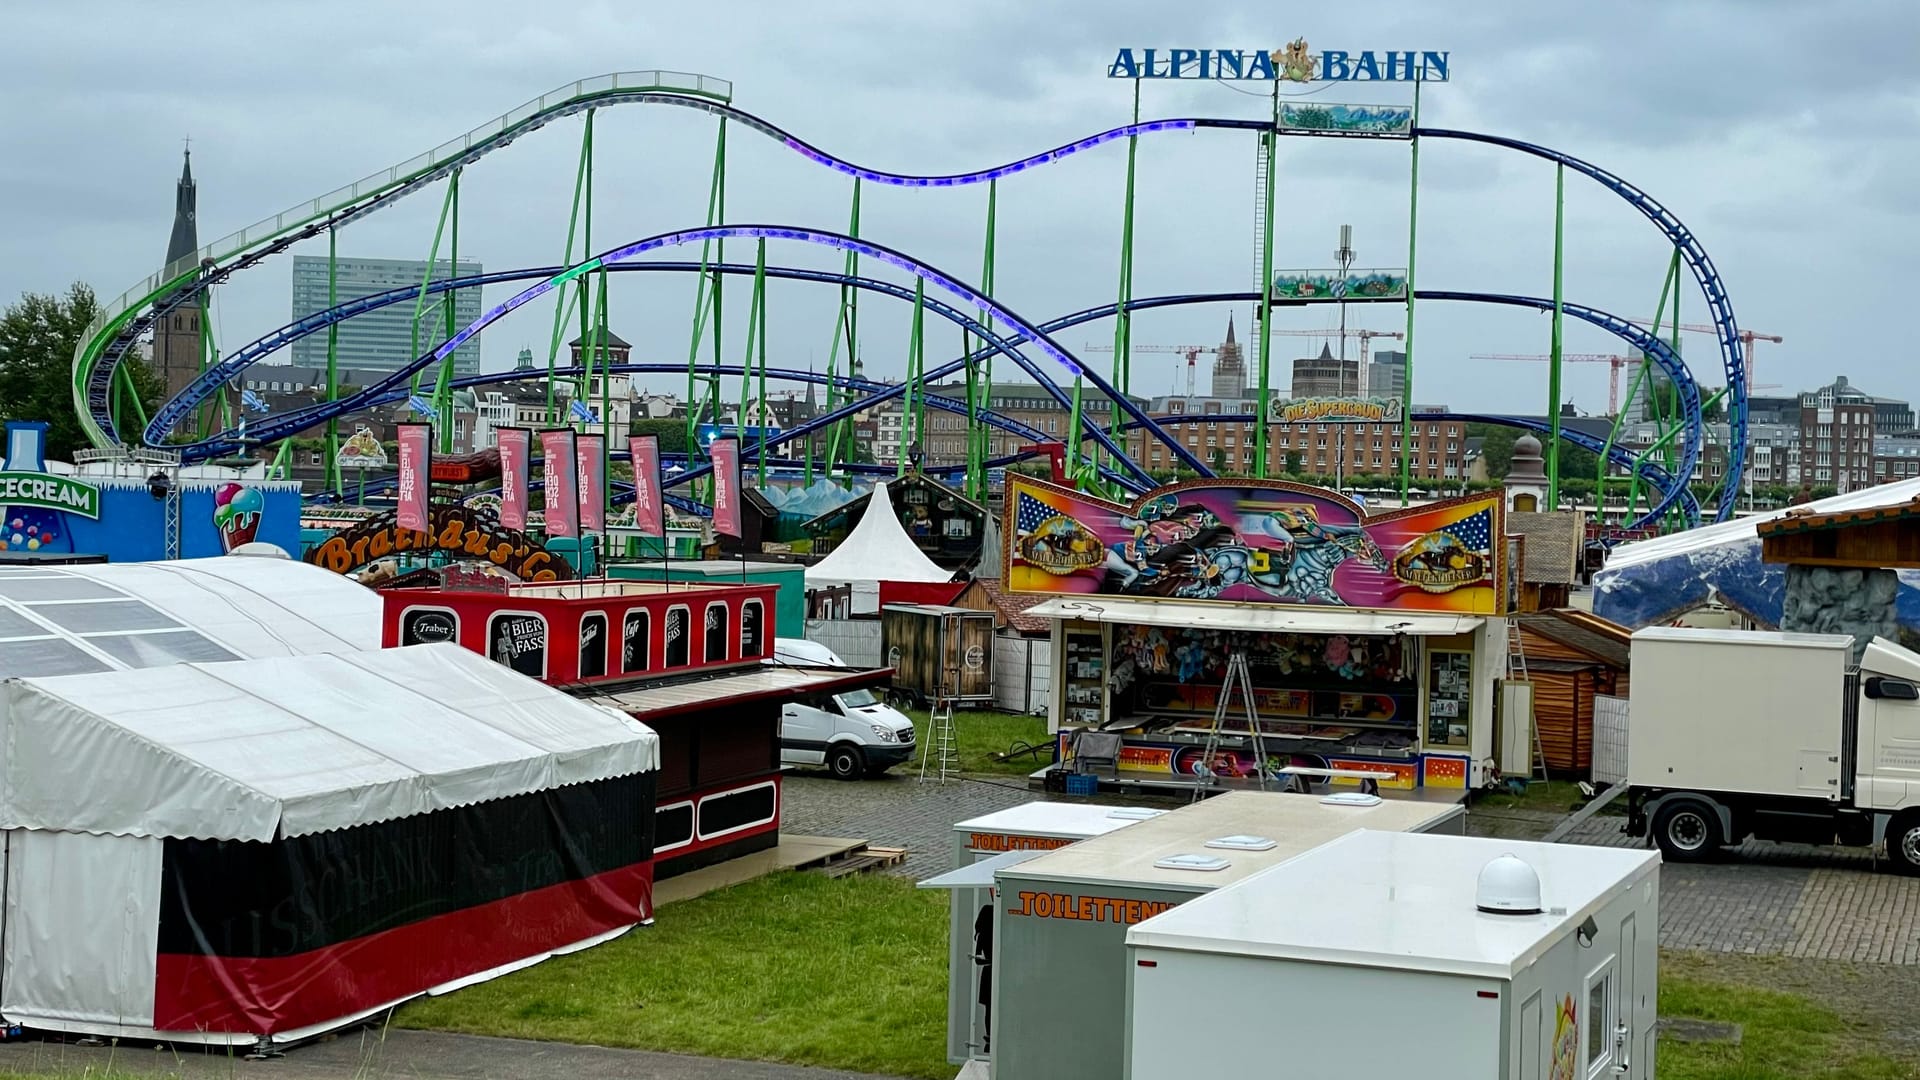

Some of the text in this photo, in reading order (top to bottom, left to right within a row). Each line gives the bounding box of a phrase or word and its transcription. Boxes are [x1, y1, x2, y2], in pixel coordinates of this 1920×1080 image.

[1108, 48, 1450, 82] ALPINA BAHN
[1285, 399, 1385, 422] DIE SUPERGAUDI
[419, 622, 448, 635] Traber
[512, 619, 543, 636] BIER
[667, 627, 681, 643] FASS
[515, 636, 544, 653] FASS
